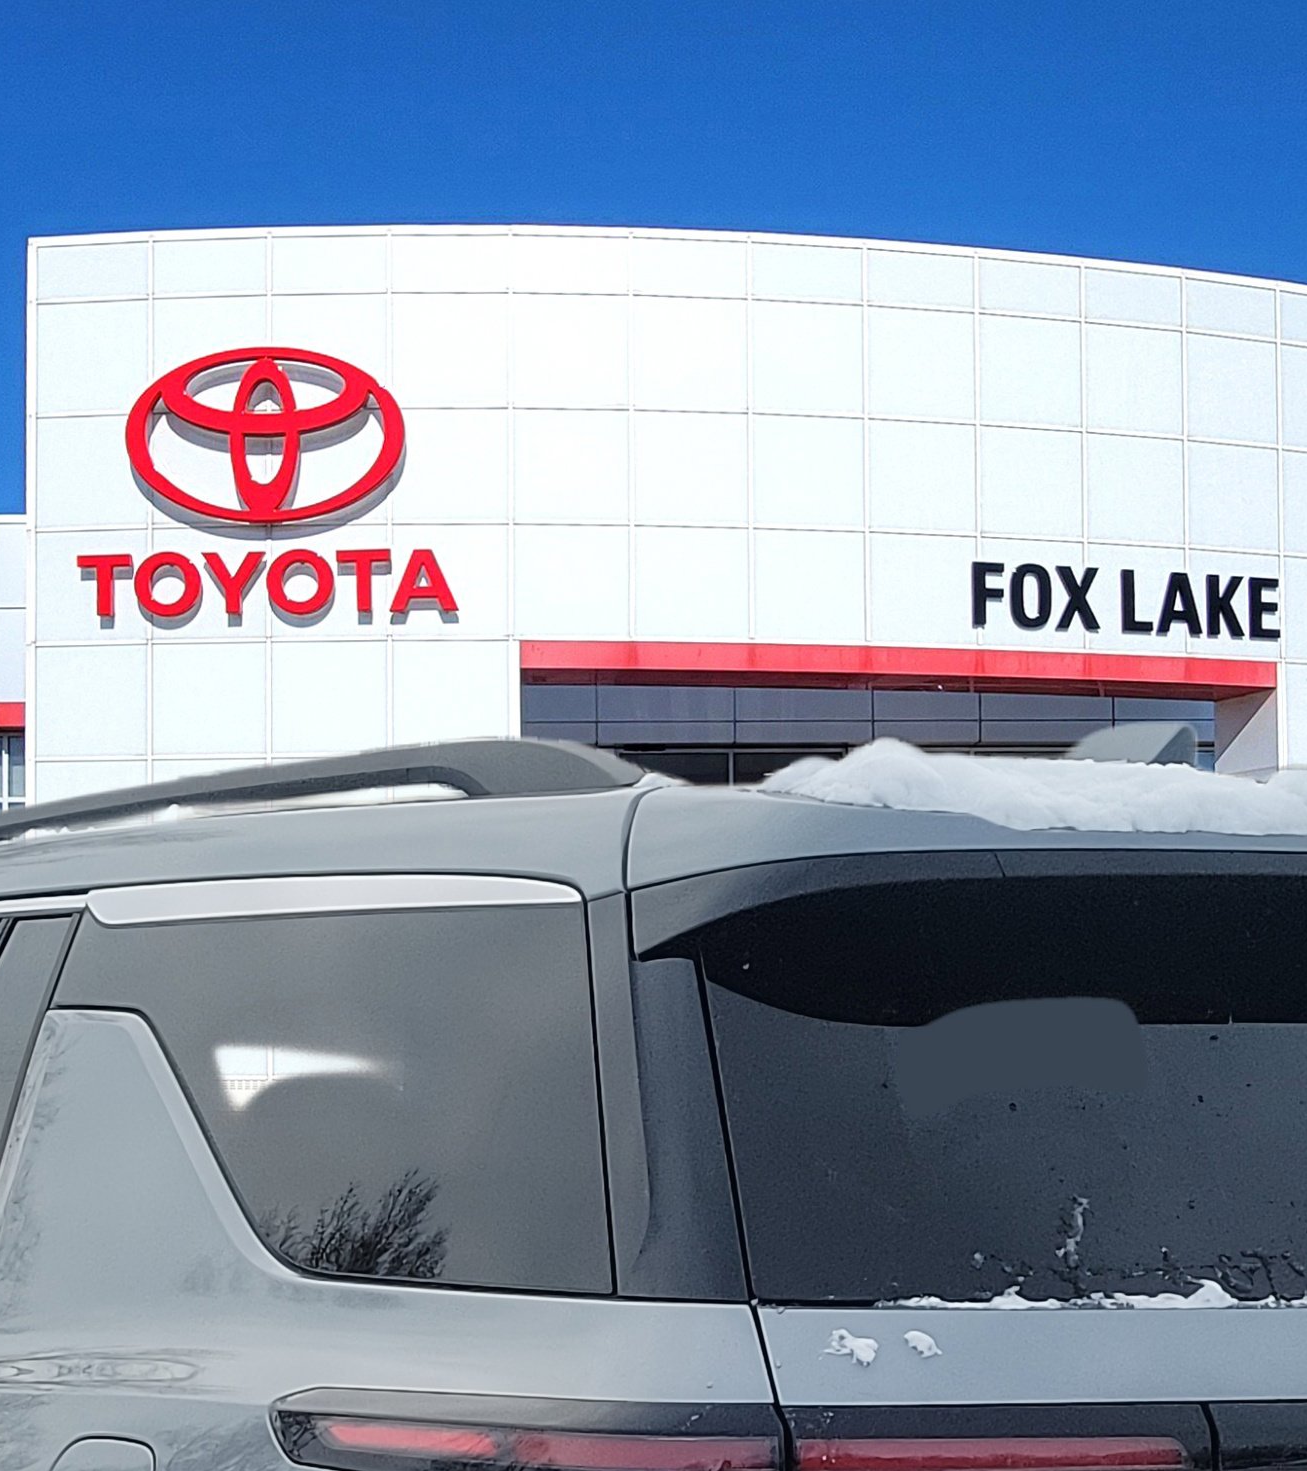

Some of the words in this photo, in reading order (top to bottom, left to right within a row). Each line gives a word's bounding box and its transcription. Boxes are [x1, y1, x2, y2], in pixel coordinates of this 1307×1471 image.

[77, 549, 459, 617] TOYOTA
[971, 561, 1100, 632] FOX
[1120, 569, 1281, 640] LAKE
